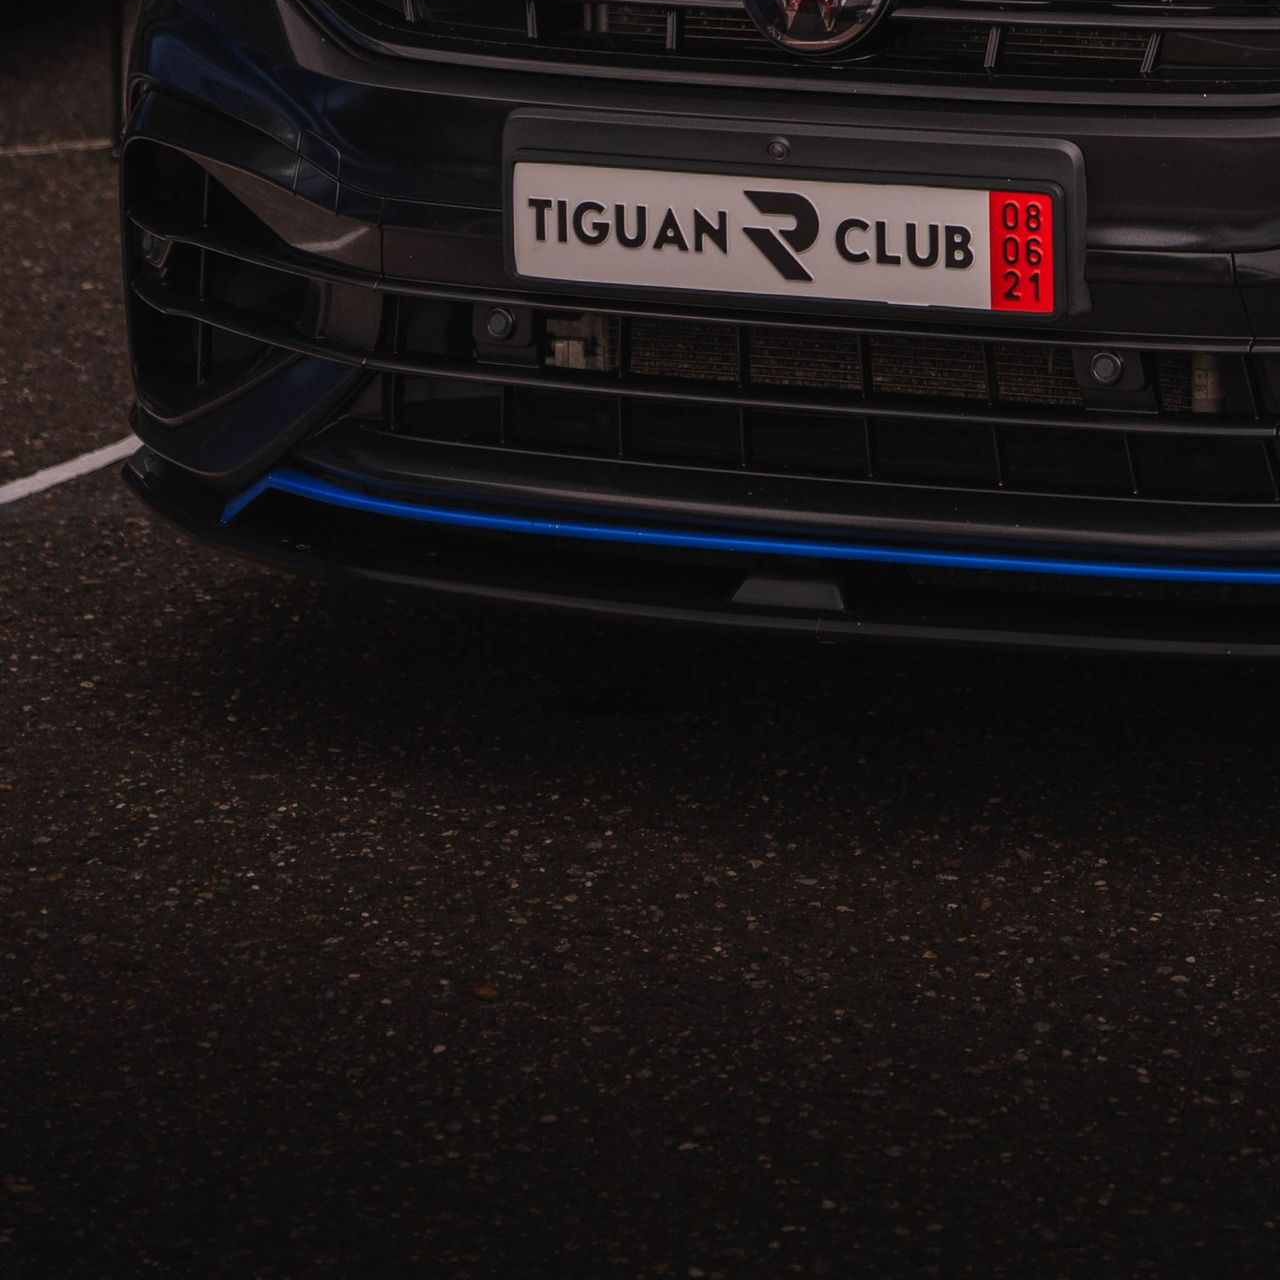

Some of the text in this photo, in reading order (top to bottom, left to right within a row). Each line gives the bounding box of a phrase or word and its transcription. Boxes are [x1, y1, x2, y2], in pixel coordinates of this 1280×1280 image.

[1003, 201, 1042, 232] 08
[528, 190, 976, 282] TIGUAN R CLUB
[1003, 236, 1043, 267] 06
[1003, 271, 1041, 301] 21
